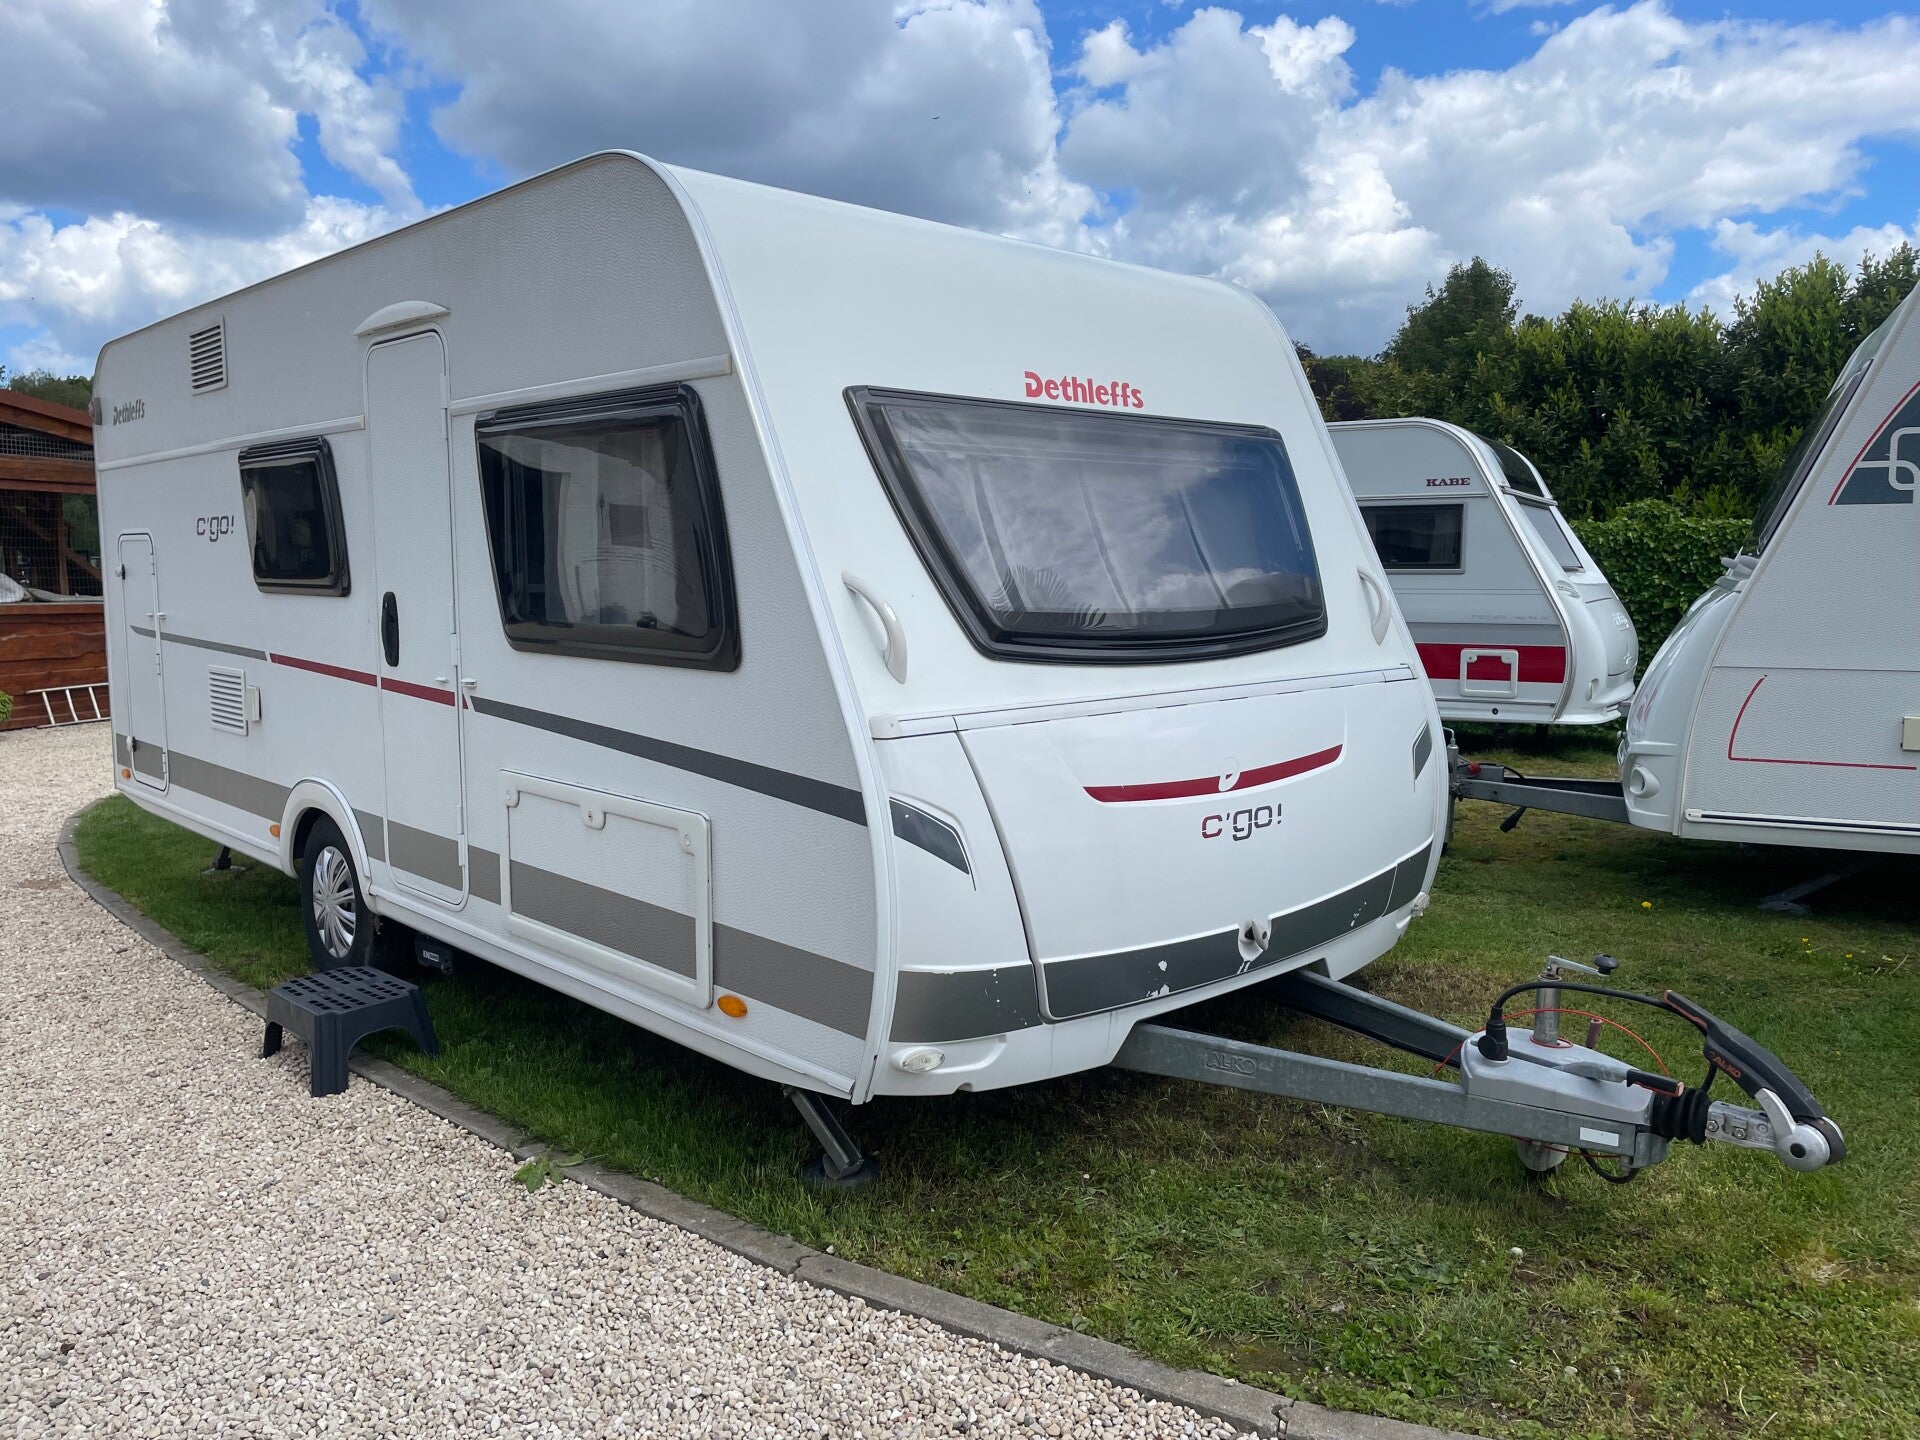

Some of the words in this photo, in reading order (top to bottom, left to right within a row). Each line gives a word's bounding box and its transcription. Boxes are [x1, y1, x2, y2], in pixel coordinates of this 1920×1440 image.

[1024, 370, 1144, 408] Dethleffs
[113, 399, 145, 426] Dethleffs
[1426, 477, 1471, 487] KABE
[1205, 1050, 1257, 1074] AL-KO
